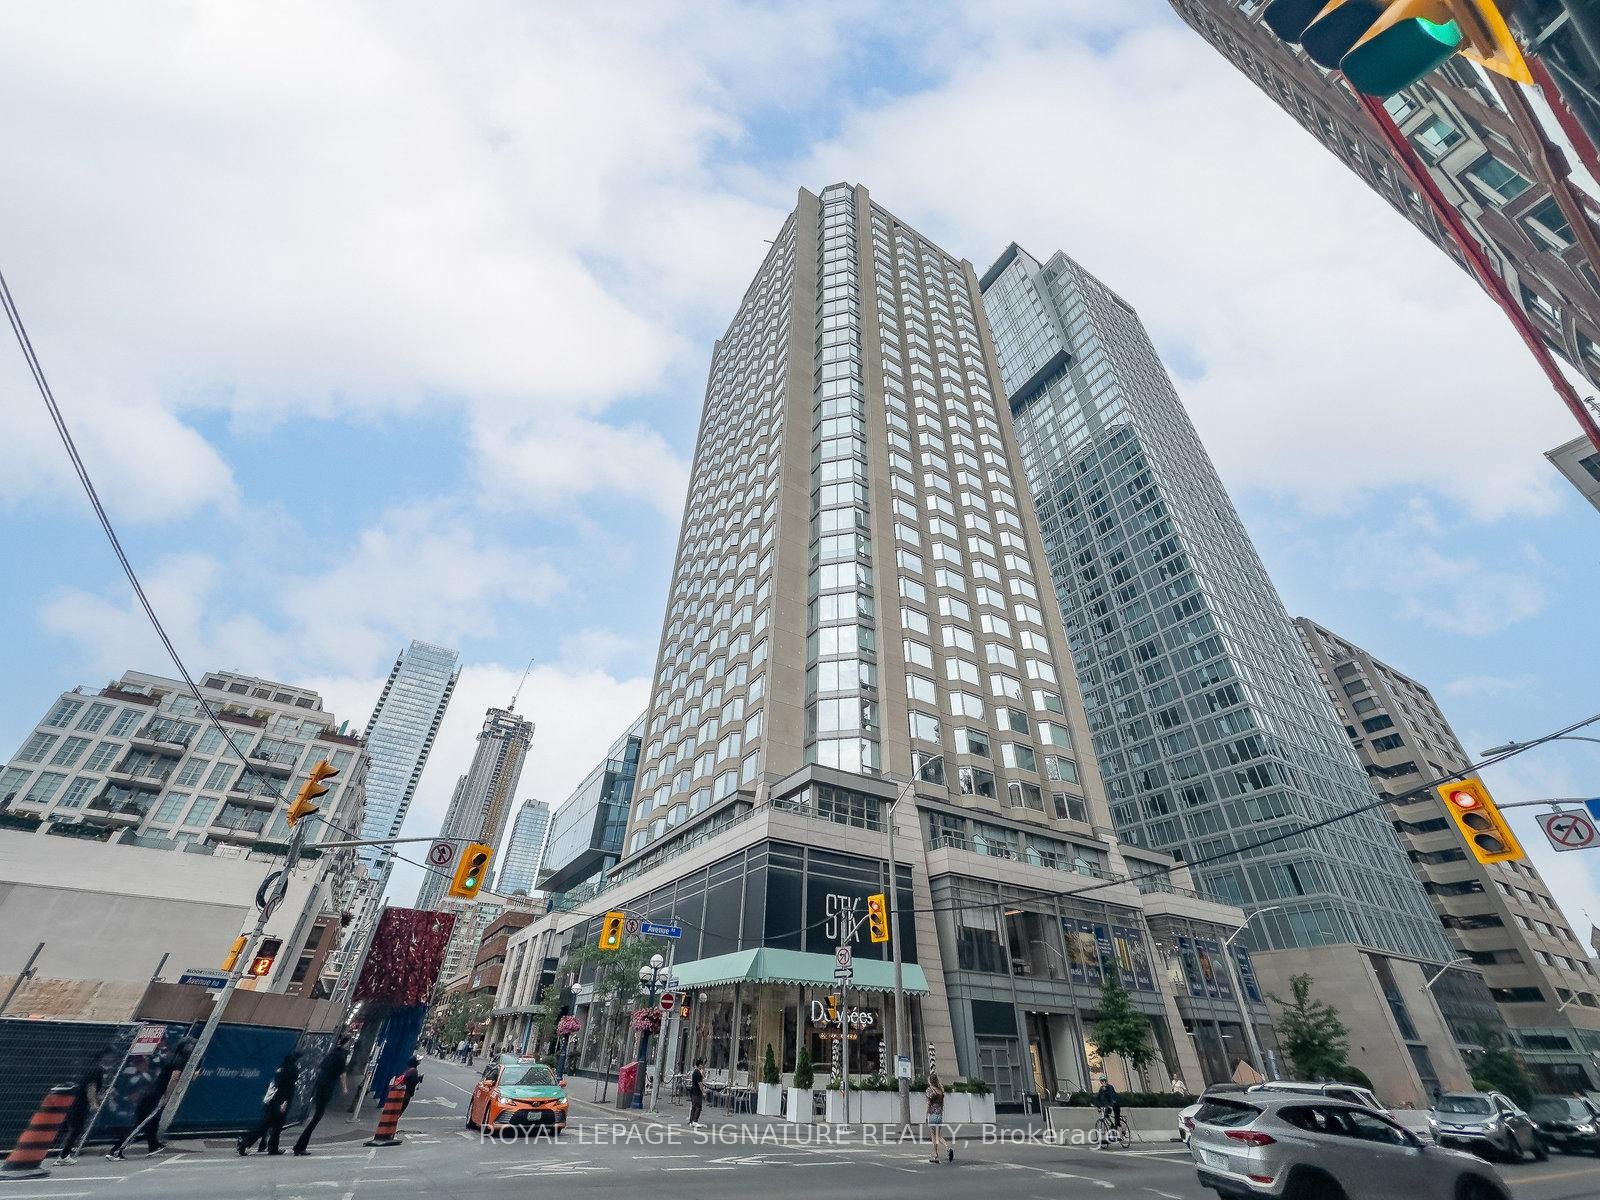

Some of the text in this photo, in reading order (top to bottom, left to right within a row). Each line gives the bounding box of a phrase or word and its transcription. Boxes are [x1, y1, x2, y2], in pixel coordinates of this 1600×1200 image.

[826, 893, 860, 942] STK
[647, 925, 670, 935] Avenue
[185, 977, 211, 986] Avenue
